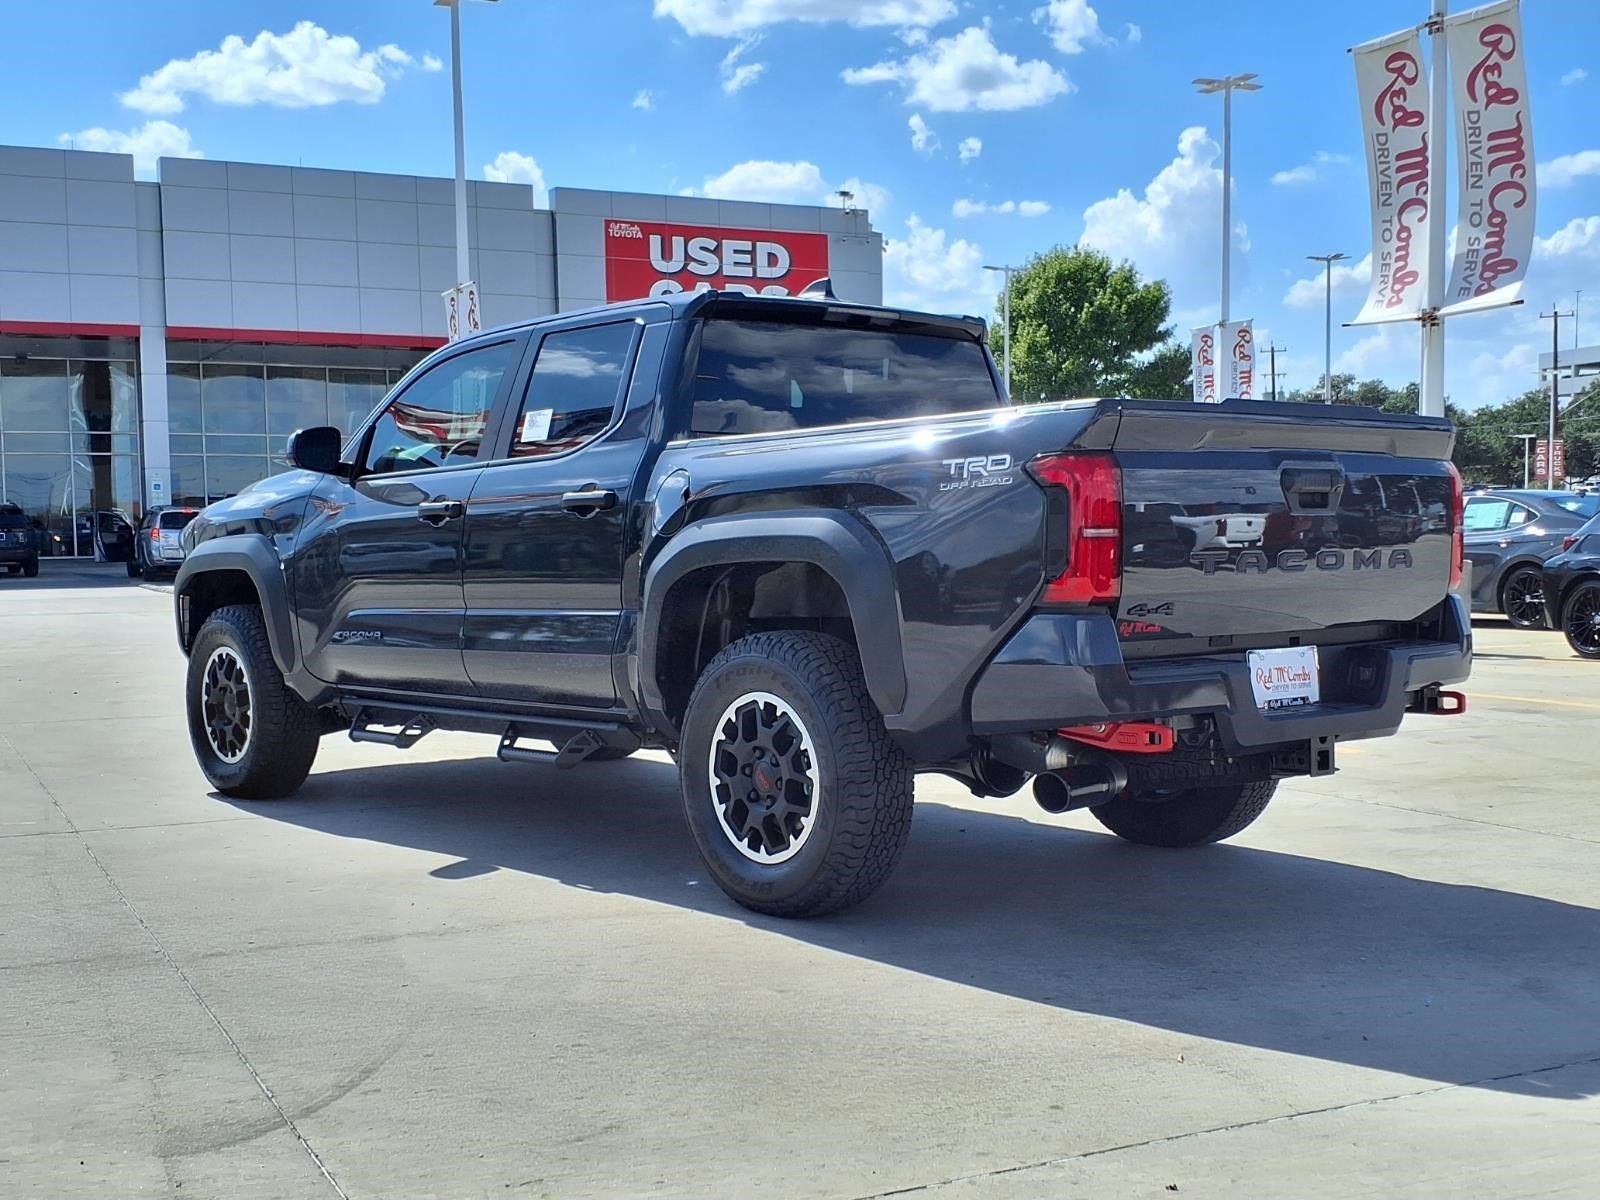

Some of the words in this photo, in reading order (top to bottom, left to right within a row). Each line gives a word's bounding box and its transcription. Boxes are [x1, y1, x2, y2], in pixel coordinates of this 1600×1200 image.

[1466, 23, 1520, 111] Red
[1374, 51, 1425, 133] Red
[1467, 110, 1483, 190] DRIVEN
[1375, 132, 1393, 208] DRIVEN
[1386, 131, 1429, 309] McCombs
[1469, 201, 1483, 229] TO
[1474, 110, 1527, 298] McCombs
[608, 229, 643, 239] TOYOTA
[1380, 216, 1393, 244] TO
[649, 235, 790, 279] USED
[1458, 236, 1481, 298] SERVE
[1374, 251, 1392, 310] SERVE
[1198, 334, 1214, 366] Red
[1233, 329, 1252, 361] Red
[942, 454, 1012, 479] TRD
[1536, 447, 1546, 475] CARS
[1554, 446, 1562, 476] TRUCKS
[1190, 548, 1413, 577] TACOMA
[1256, 667, 1274, 690] Red
[1273, 665, 1311, 683] McCombs
